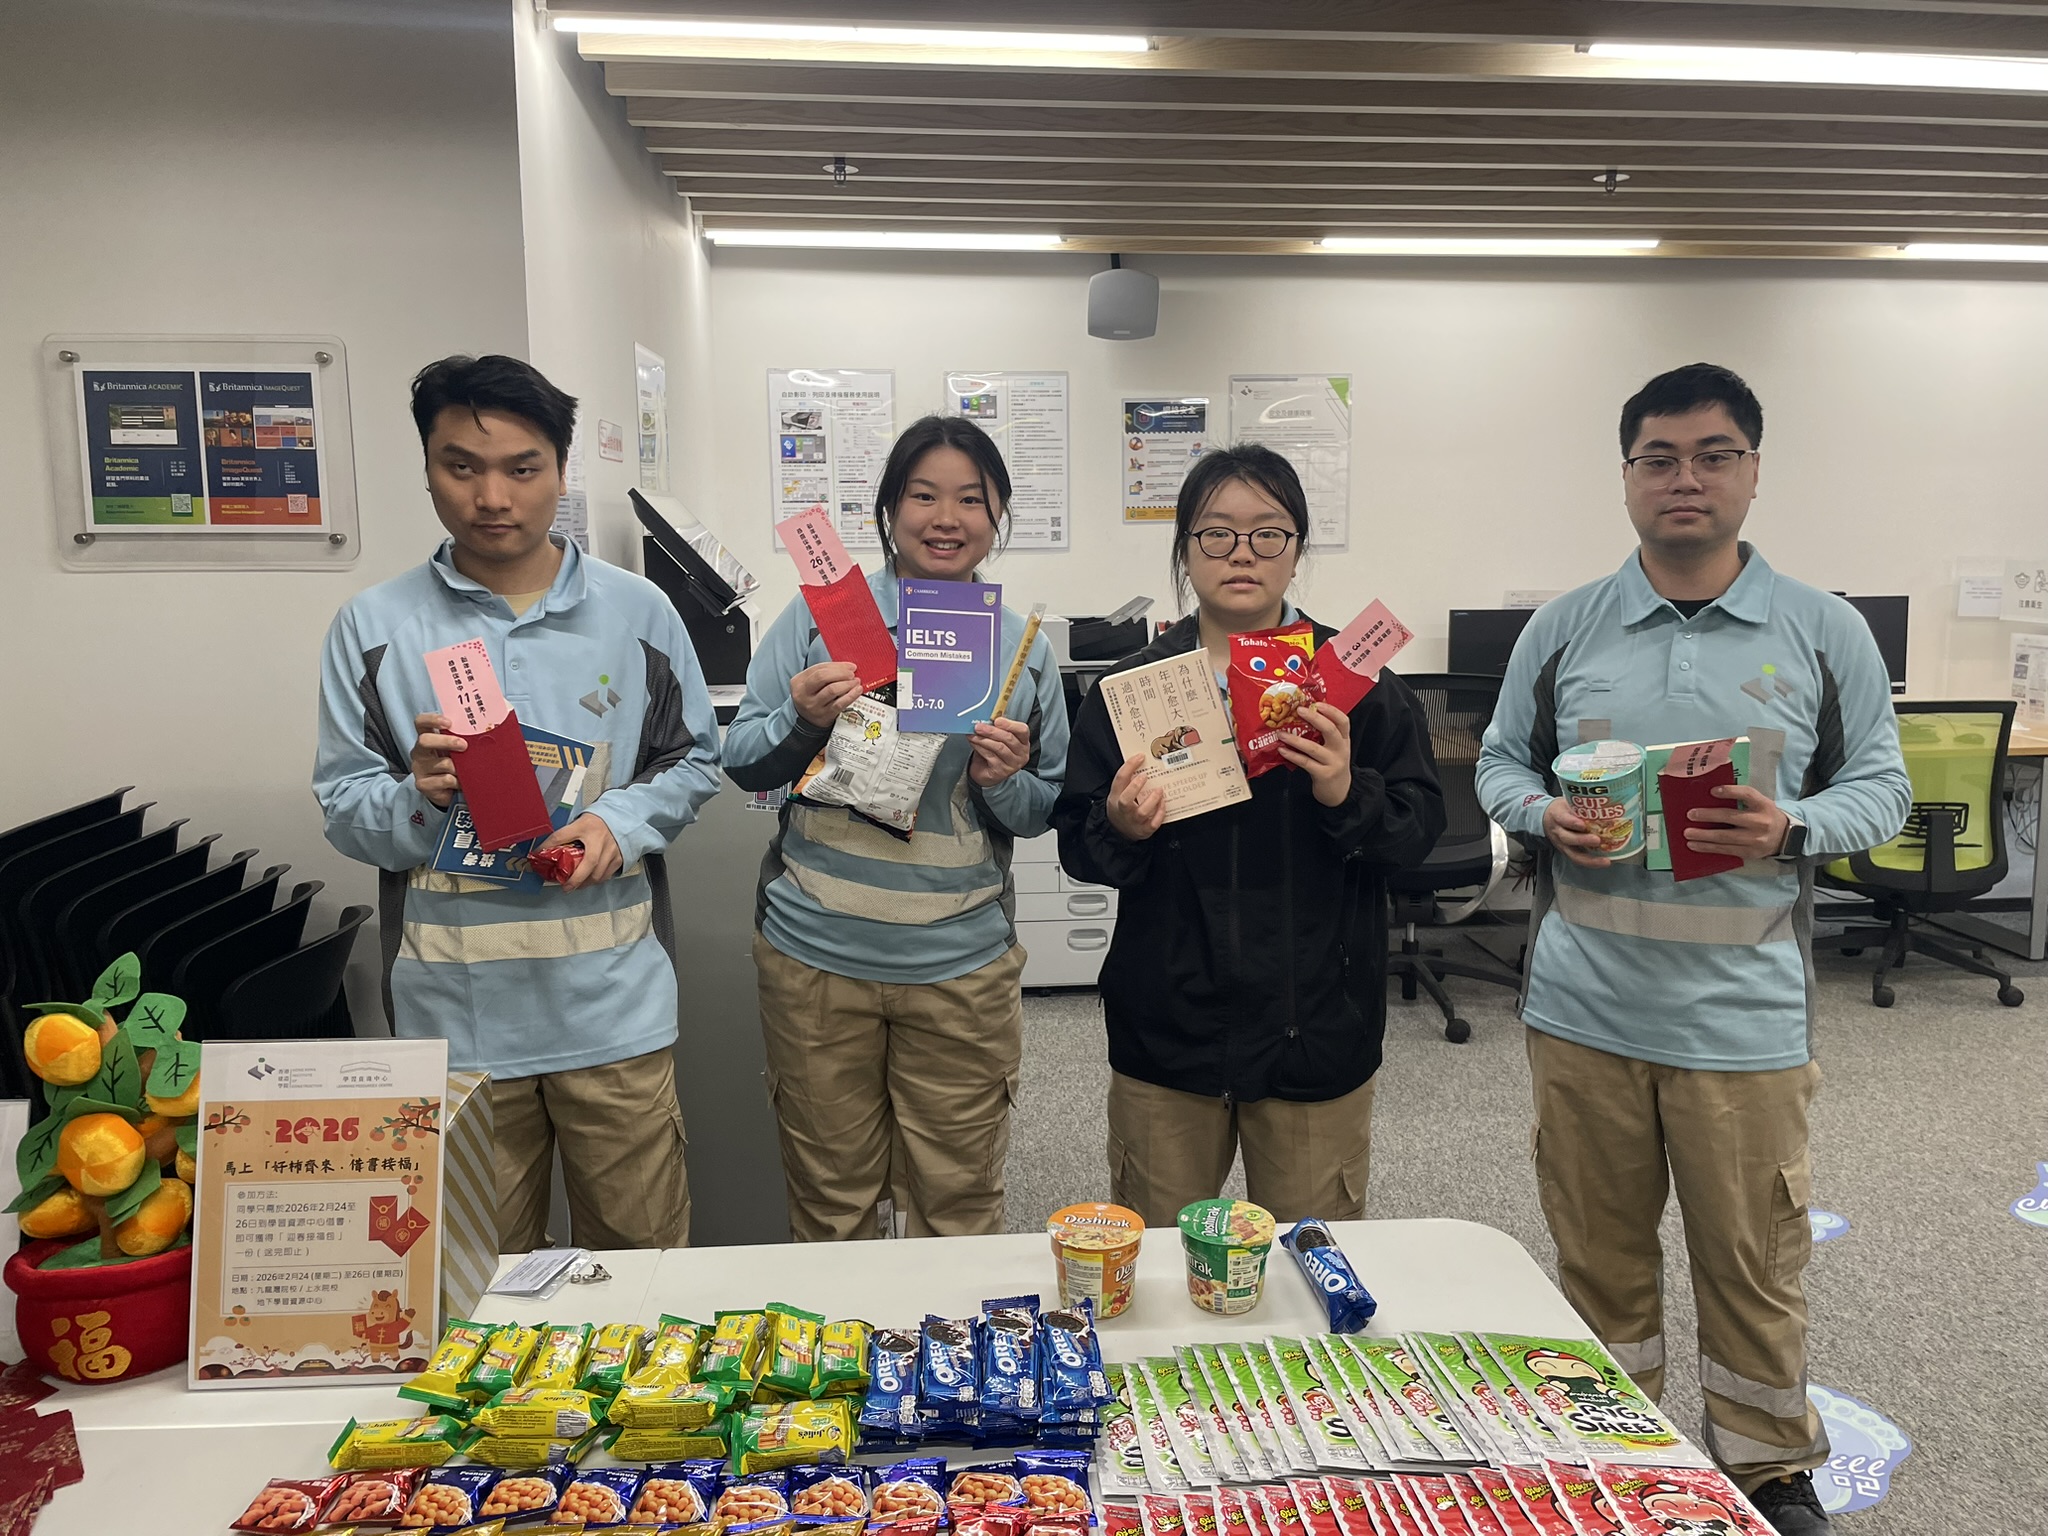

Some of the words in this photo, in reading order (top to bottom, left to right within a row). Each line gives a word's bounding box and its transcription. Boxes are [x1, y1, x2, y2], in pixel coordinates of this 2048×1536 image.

[106, 382, 147, 391] Britannica
[148, 383, 184, 391] ACADEMIC
[222, 382, 263, 392] Britannica
[906, 628, 957, 647] IELTS
[1238, 636, 1268, 648] Tohato
[906, 650, 939, 658] Common
[940, 651, 971, 660] Mistakes
[1138, 675, 1157, 702] 時間
[1172, 775, 1198, 788] SPEEDS
[1198, 772, 1208, 780] UP
[1183, 781, 1207, 793] OLDER
[1567, 784, 1609, 796] BIG
[1571, 796, 1609, 810] CUP
[275, 1116, 360, 1145] 2026
[1064, 1214, 1131, 1229] Doshirak
[1201, 1205, 1223, 1238] Doshirak
[1304, 1250, 1348, 1293] OREO
[48, 1310, 132, 1381] 福
[994, 1330, 1018, 1373] OREO
[1050, 1327, 1083, 1368] OREO
[878, 1351, 900, 1391] OREO
[931, 1341, 954, 1384] OREO
[1578, 1403, 1640, 1420] BIG
[1567, 1412, 1666, 1434] SHEET
[797, 1429, 825, 1439] Julie's
[606, 1471, 638, 1479] Peanuts
